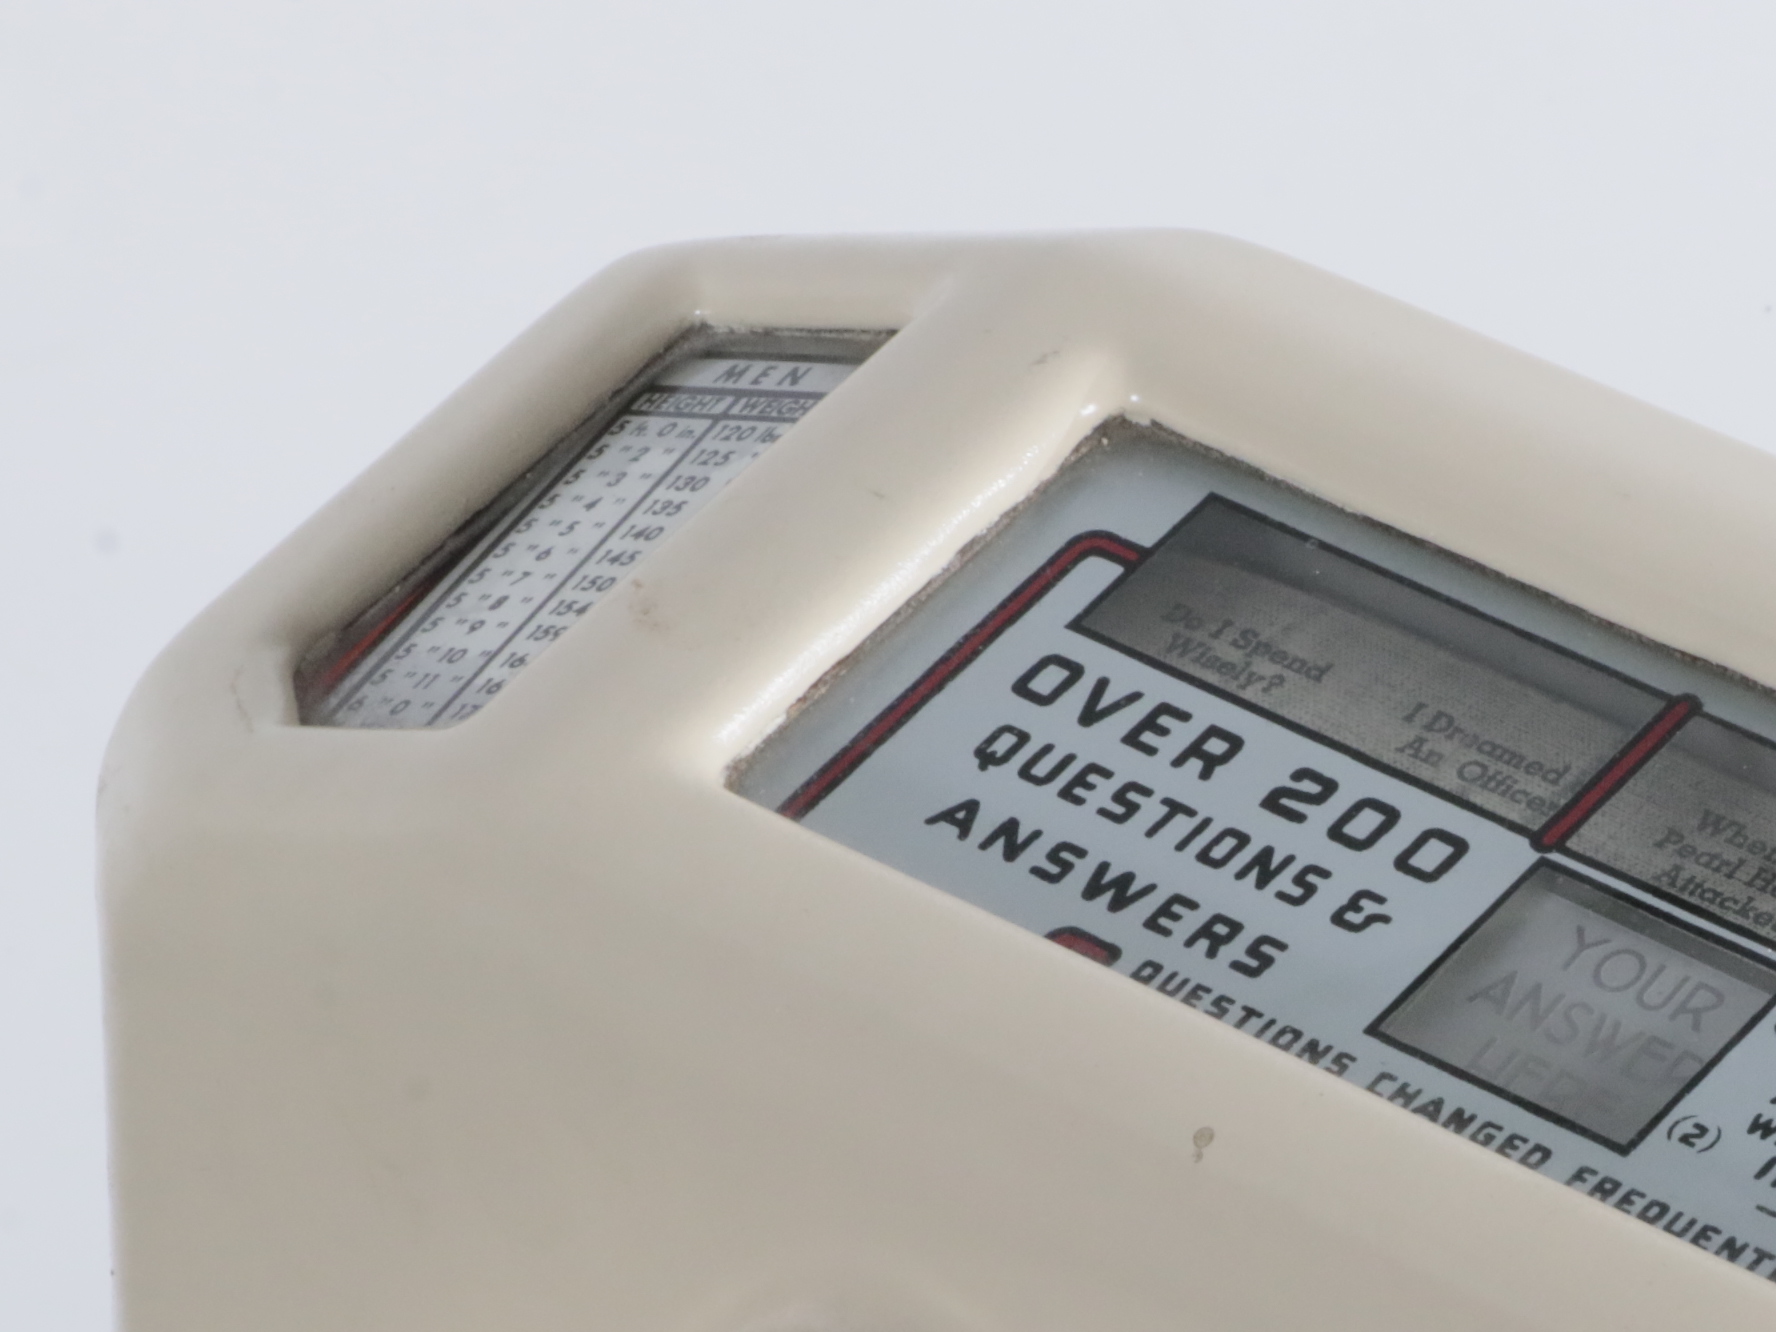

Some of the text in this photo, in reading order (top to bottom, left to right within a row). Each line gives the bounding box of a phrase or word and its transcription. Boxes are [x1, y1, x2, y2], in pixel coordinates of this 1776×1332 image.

[713, 363, 812, 387] MEN
[639, 393, 726, 413] HEIGHT
[608, 420, 631, 436] 5
[712, 425, 755, 442] 120
[629, 446, 651, 462] 2
[690, 450, 736, 466] 125
[606, 472, 628, 487] 3
[666, 476, 710, 492] 130
[583, 497, 604, 512] 4
[643, 500, 688, 517] 135
[558, 521, 581, 536] 5
[619, 524, 665, 541] 140
[535, 546, 554, 561] 6
[596, 550, 642, 566] 145
[510, 571, 533, 586] 7
[571, 575, 617, 592] 150
[488, 595, 511, 611] 8
[549, 600, 594, 616] 154
[465, 620, 486, 635] 9
[436, 648, 467, 664] 10
[1165, 632, 1286, 693] Wisely?
[1230, 627, 1334, 683] Spend
[412, 673, 441, 690] 11
[389, 700, 411, 716] 0
[1395, 735, 1443, 768] An
[1423, 709, 1573, 787] Dreamed
[1011, 653, 1470, 883] OVER 200
[973, 724, 1393, 933] QUESTIONS &
[1654, 828, 1747, 881] Pearl
[923, 798, 1289, 978] ANSWERS
[1560, 924, 1726, 1033] YOUR
[1129, 959, 1358, 1077] QUESTIONS
[1364, 1071, 1553, 1170] CHANGED
[1666, 1115, 1722, 1154] (2)
